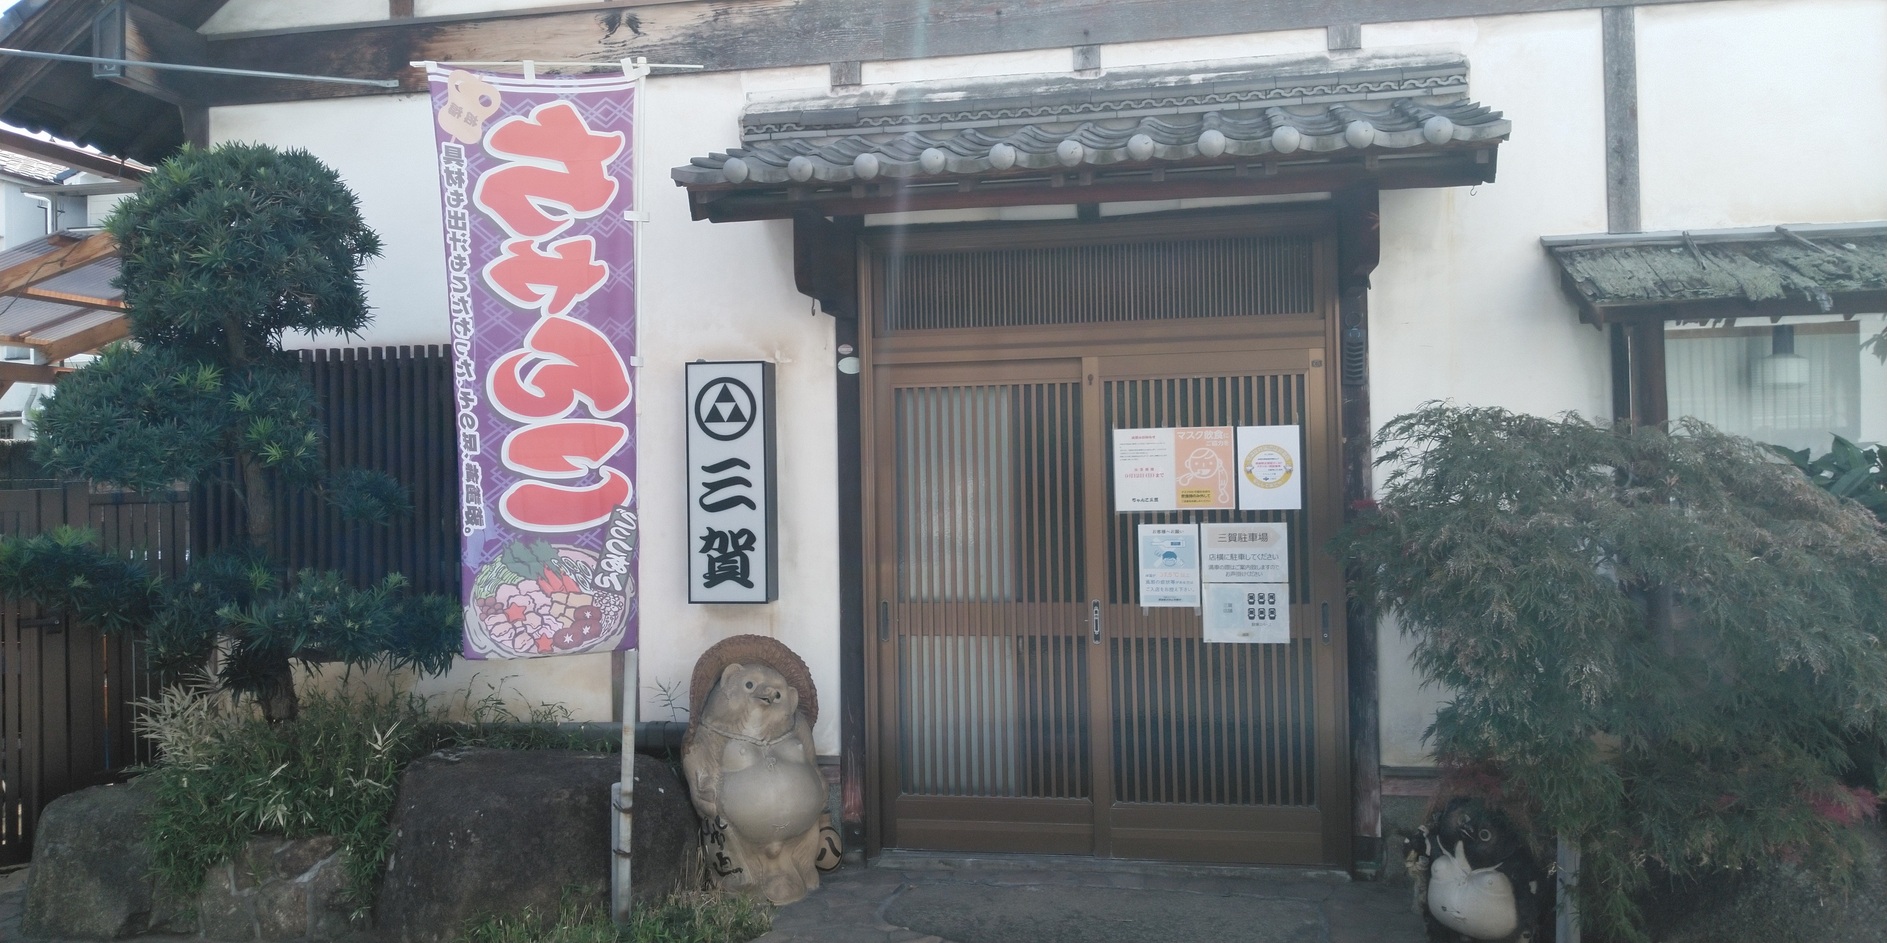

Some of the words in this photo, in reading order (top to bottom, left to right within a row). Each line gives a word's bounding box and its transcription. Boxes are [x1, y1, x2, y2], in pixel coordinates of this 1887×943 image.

[698, 457, 757, 589] 三賀
[1217, 532, 1269, 543] 三賀駐車場
[1208, 553, 1280, 561] 店横に駐車してください
